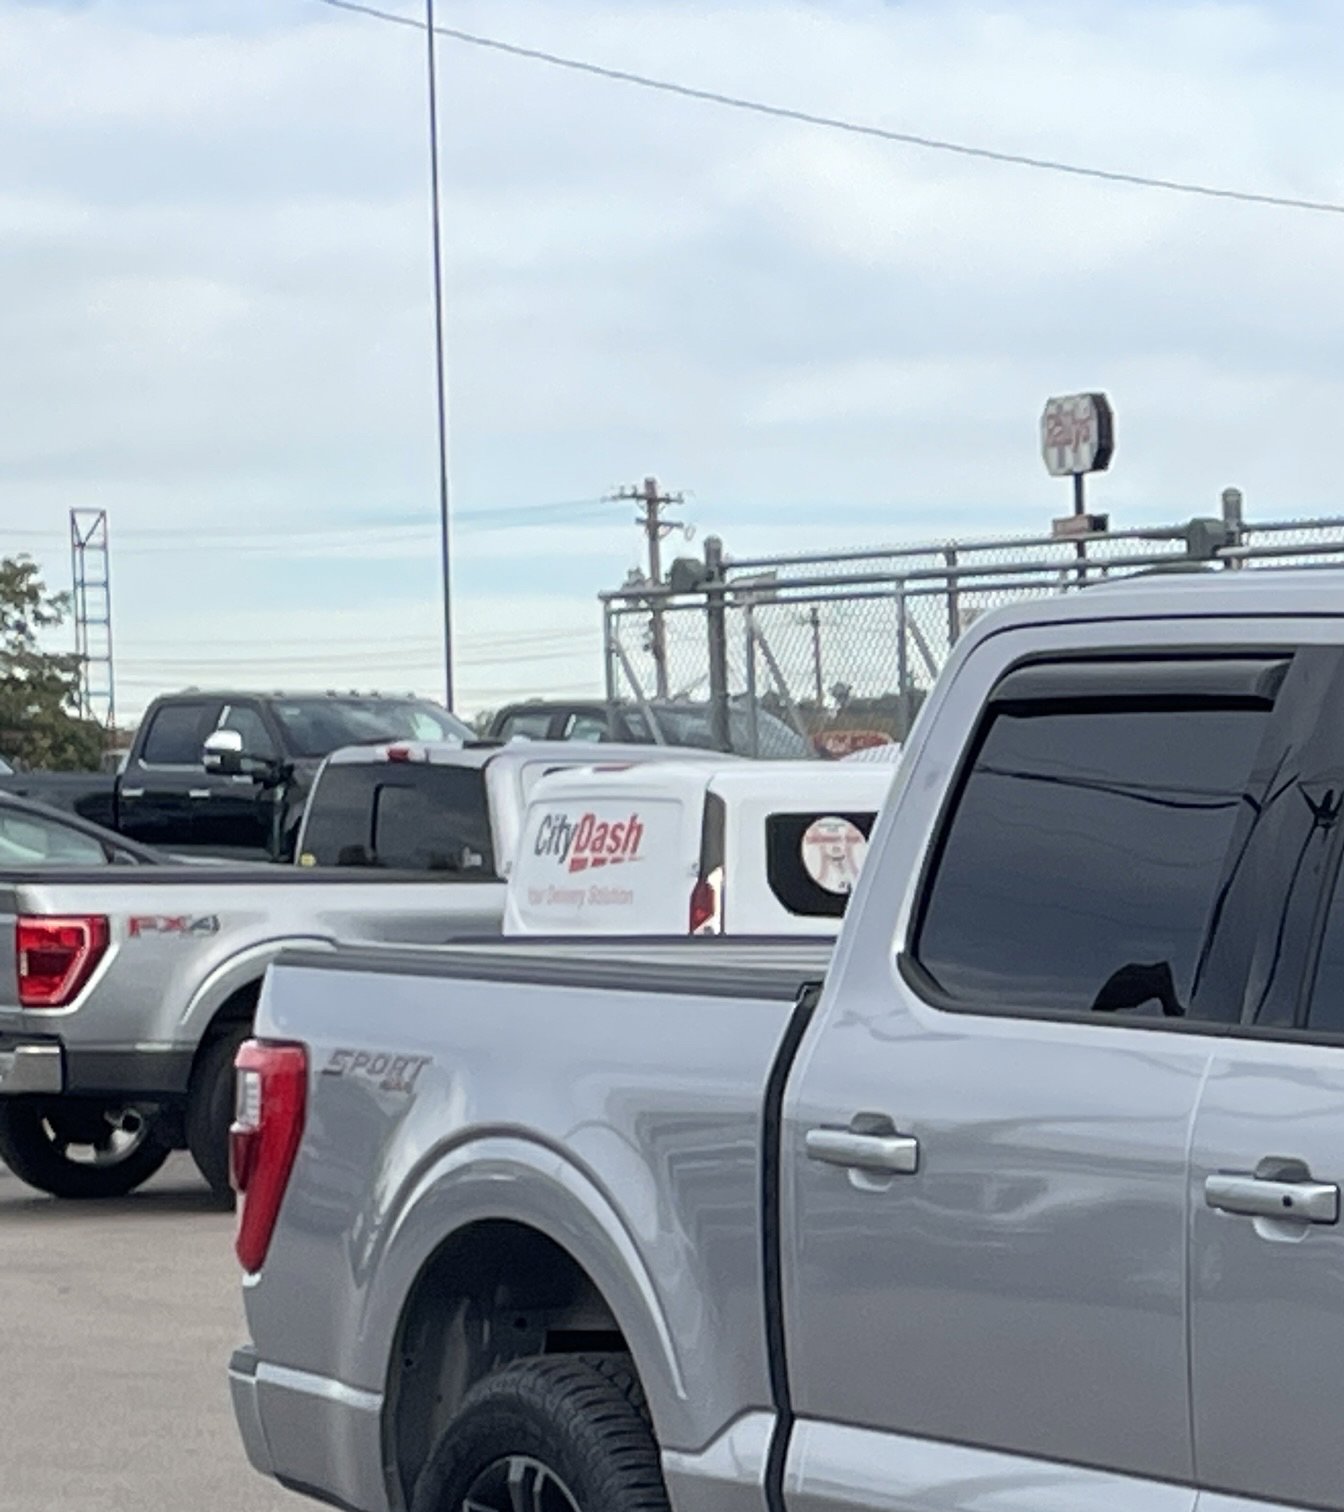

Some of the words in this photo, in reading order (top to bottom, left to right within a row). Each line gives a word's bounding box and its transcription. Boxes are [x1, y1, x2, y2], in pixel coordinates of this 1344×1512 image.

[534, 813, 643, 864] CityDash
[129, 914, 220, 937] FX4
[321, 1049, 434, 1078] SPORT
